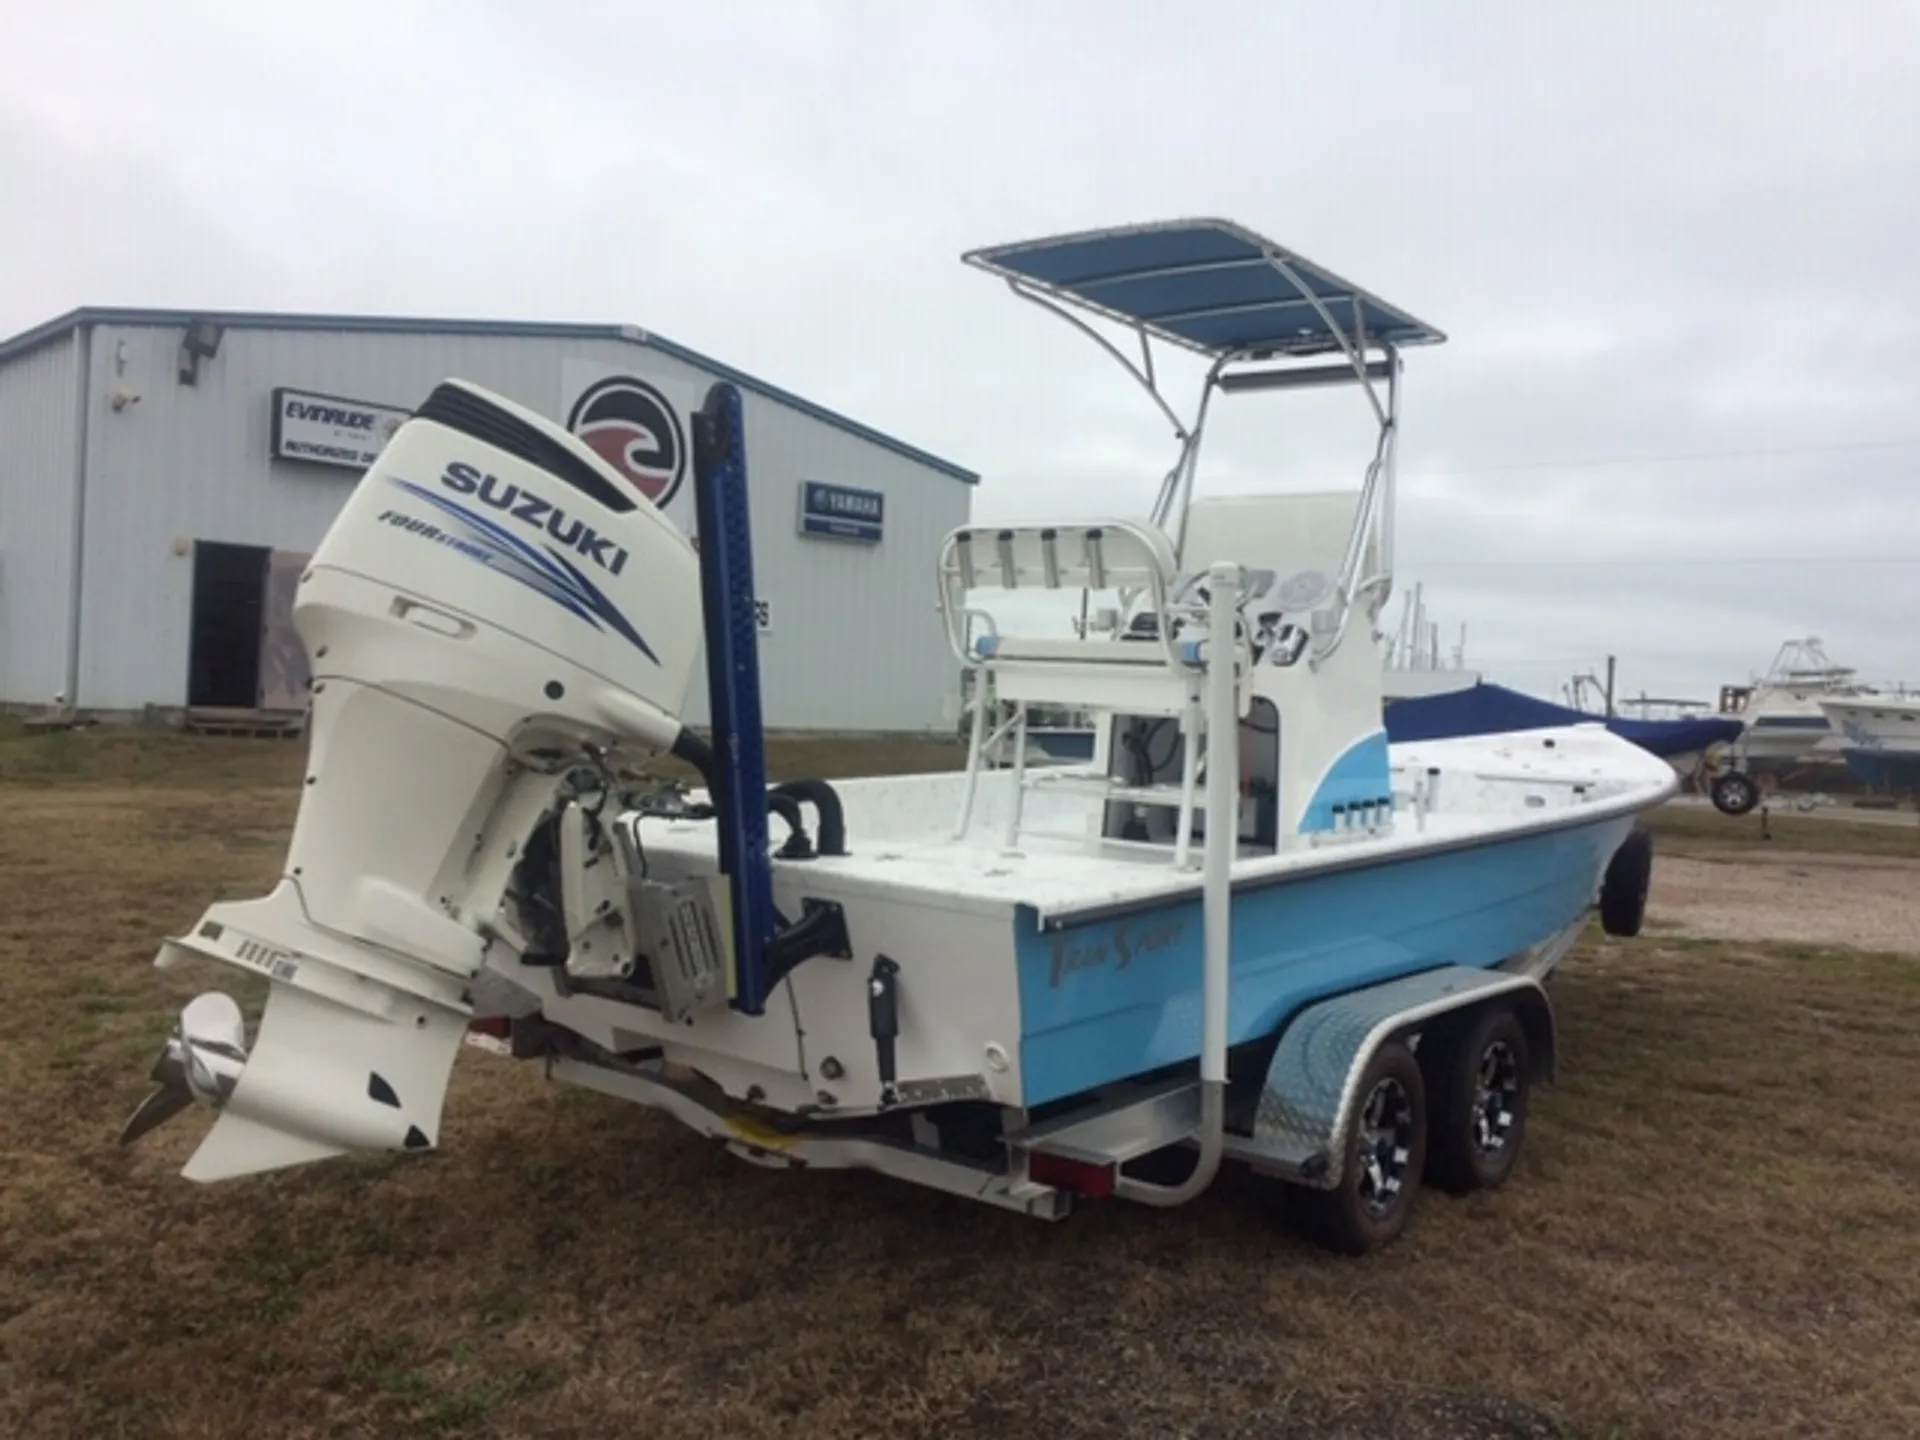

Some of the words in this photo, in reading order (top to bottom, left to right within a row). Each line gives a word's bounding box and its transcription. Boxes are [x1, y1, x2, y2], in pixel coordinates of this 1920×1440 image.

[285, 401, 375, 430] EVINRUDE
[285, 440, 358, 462] AUTHORIZED
[830, 492, 878, 515] YAMAHA
[440, 461, 629, 577] SUZUKI
